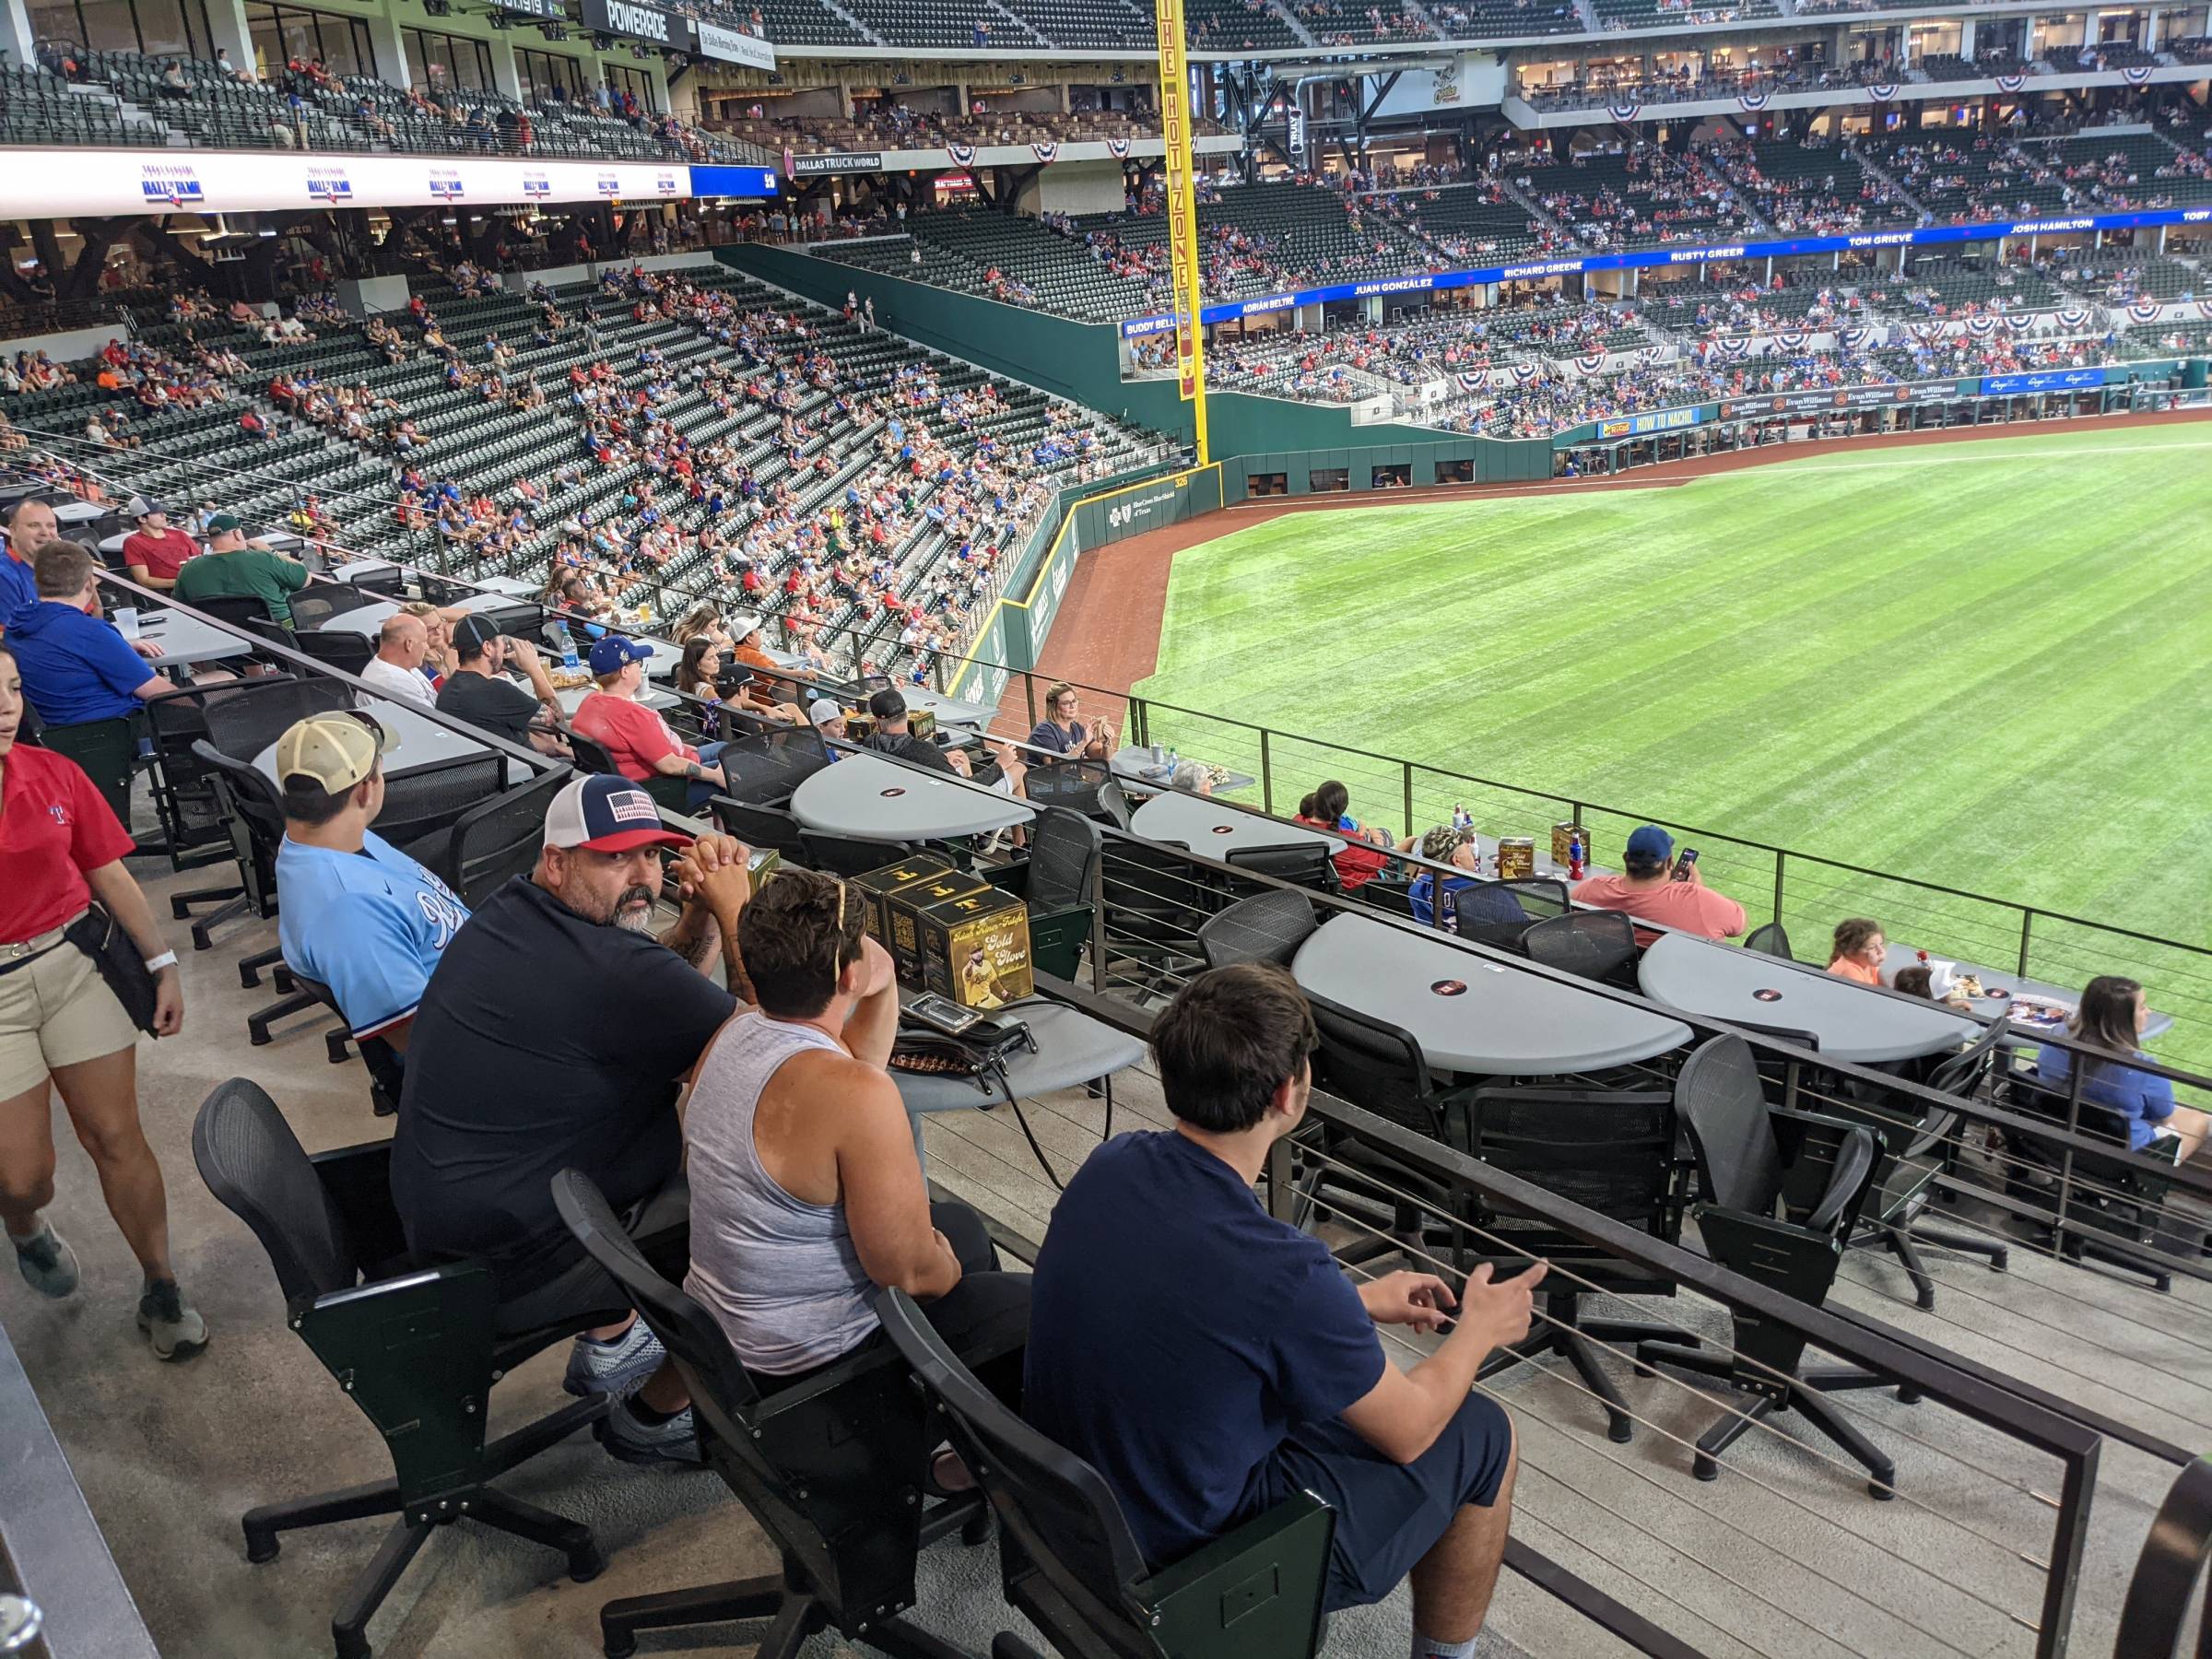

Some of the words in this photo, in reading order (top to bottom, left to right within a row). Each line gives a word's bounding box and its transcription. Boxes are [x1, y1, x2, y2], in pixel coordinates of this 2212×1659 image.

[606, 1, 669, 41] POWERADE
[1167, 96, 1179, 168] HOT
[795, 160, 825, 170] DALLAS
[825, 158, 853, 168] TRUCK
[853, 158, 880, 167] WORLD
[2183, 212, 2210, 221] TOBY
[2010, 223, 2038, 234] JOSH
[2040, 219, 2094, 231] HAMILTON
[1173, 192, 1186, 286] ZONE
[1849, 237, 1872, 246] TOM
[1874, 234, 1912, 244] GRIEVE
[1671, 251, 1706, 262] RUSTY
[1708, 247, 1744, 258] GREER
[1504, 265, 1545, 277] RICHARD
[1547, 262, 1583, 274] GREENE
[1354, 284, 1380, 295] JUAN
[1382, 278, 1432, 292] GONZÁLEZ
[1243, 300, 1269, 313] ADRIÁN
[1269, 295, 1295, 309] BELTRÉ
[1127, 323, 1154, 335] BUDDY
[1156, 318, 1176, 330] BELL
[1637, 415, 1655, 432] HOW
[1656, 413, 1666, 428] TO
[1175, 477, 1188, 488] 326
[985, 932, 1014, 951] Gold
[995, 949, 1026, 966] Glove
